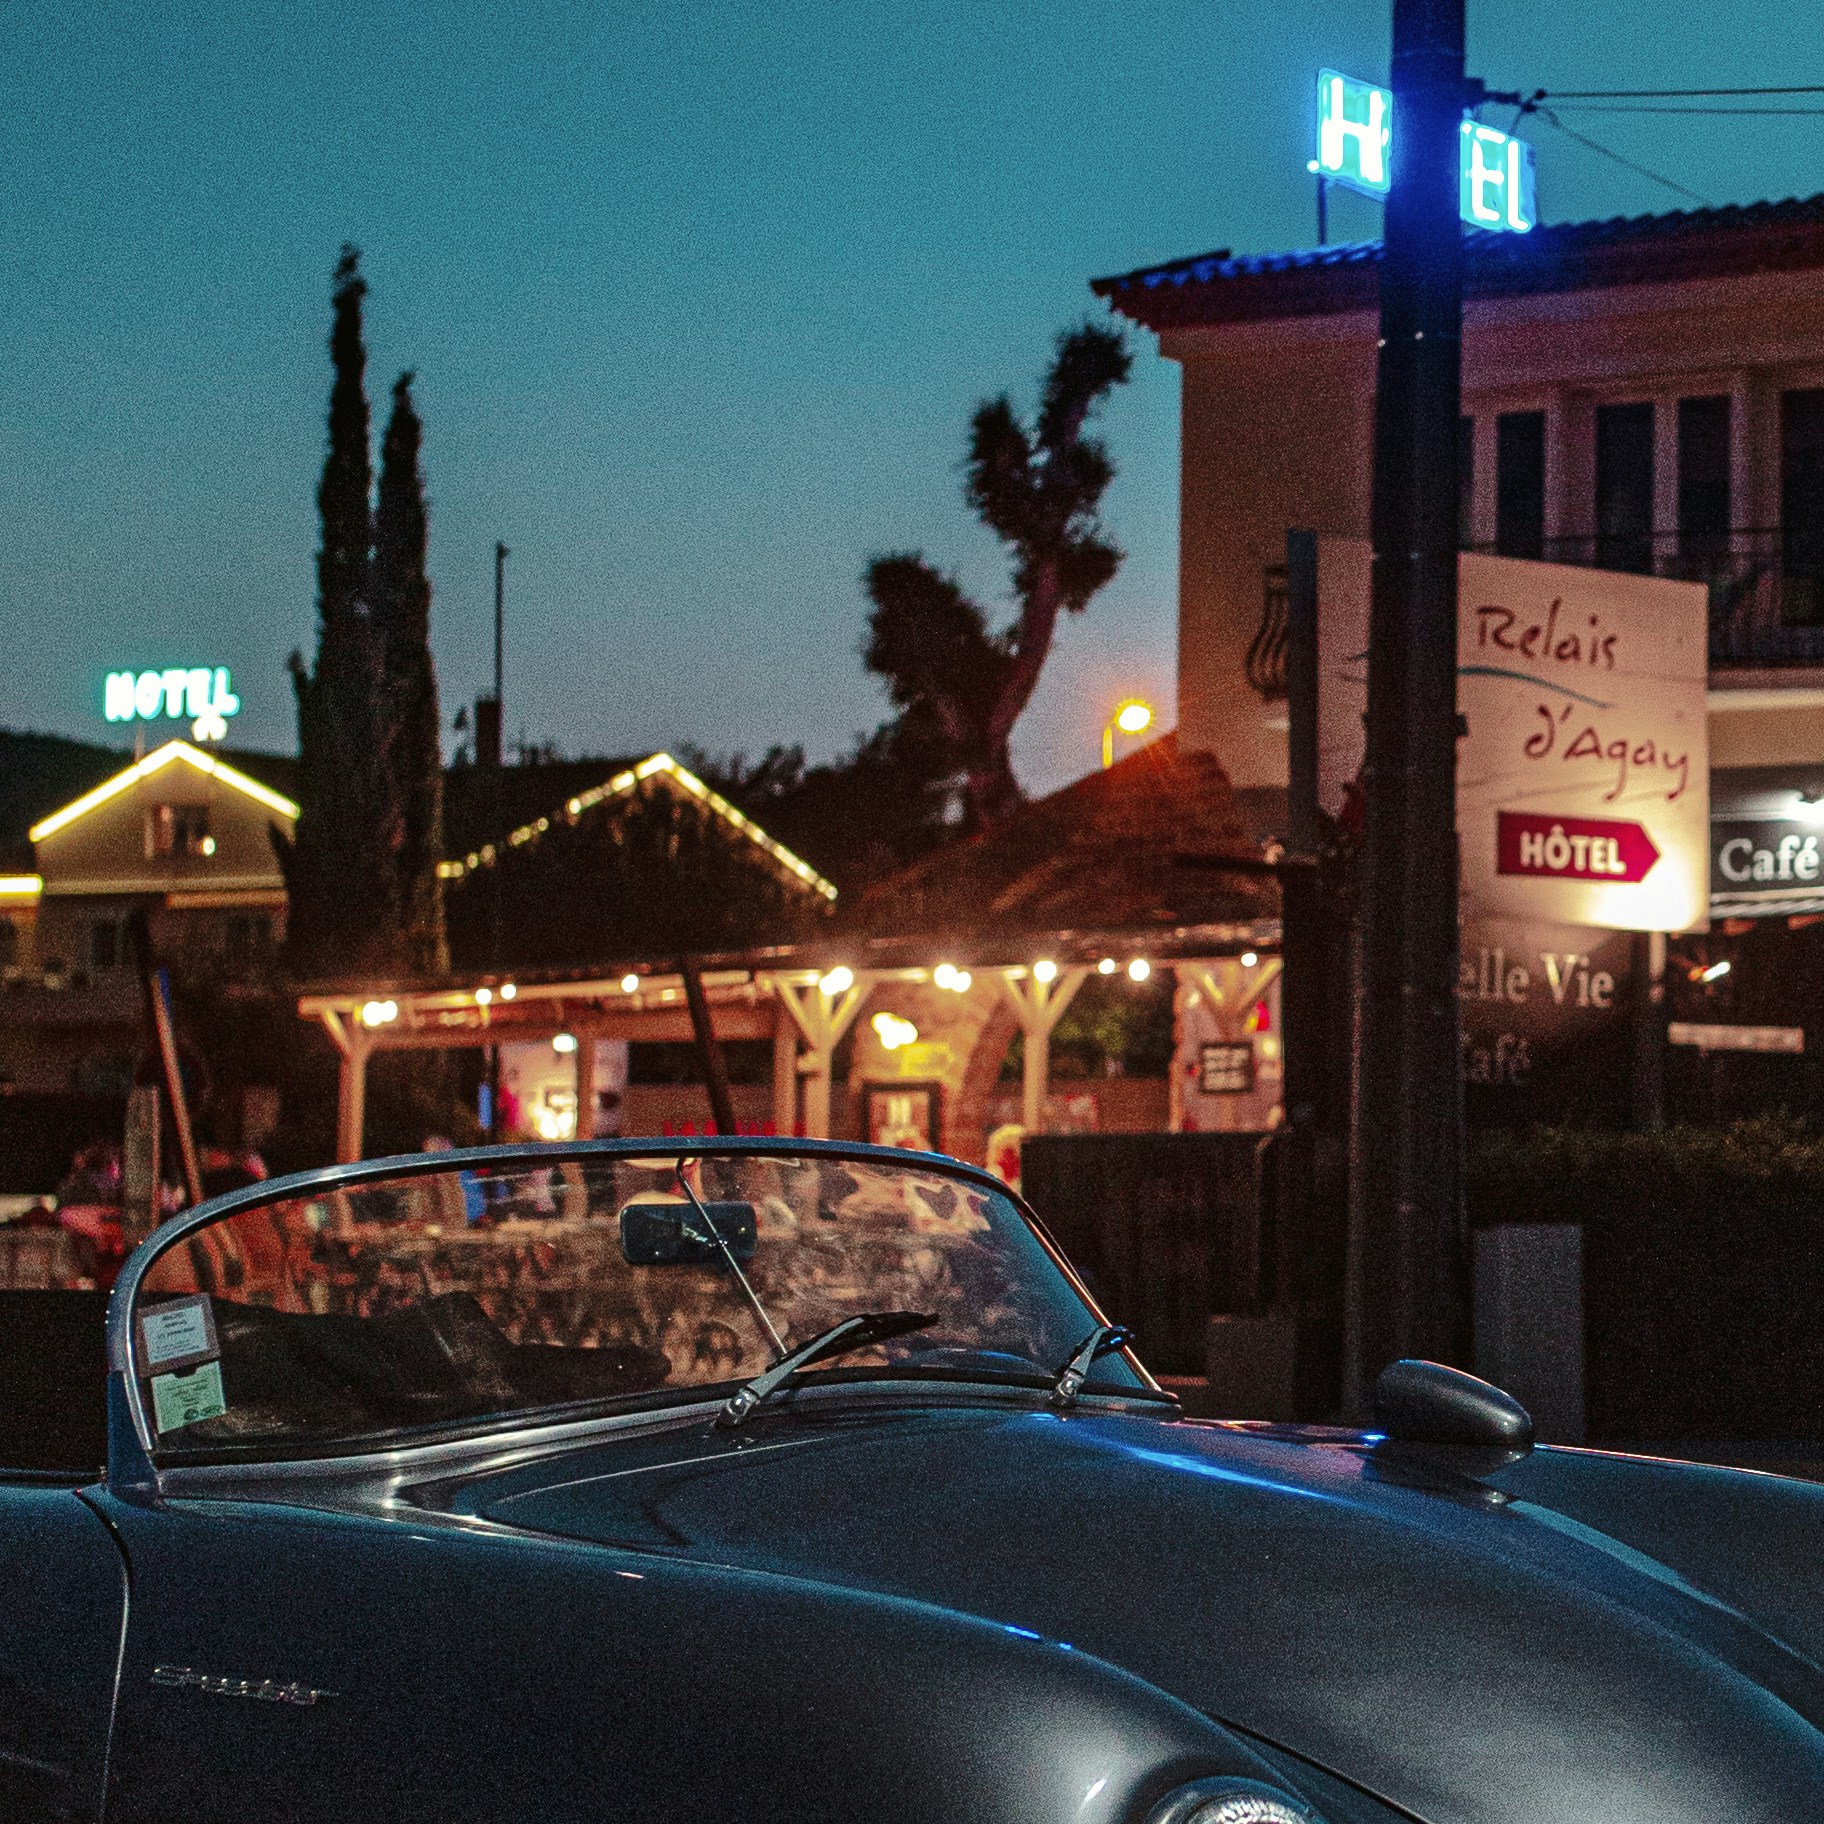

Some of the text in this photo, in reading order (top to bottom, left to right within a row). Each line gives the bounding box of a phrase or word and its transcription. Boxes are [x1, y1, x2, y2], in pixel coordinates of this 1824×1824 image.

[1316, 69, 1533, 234] HEL
[1476, 596, 1617, 671] Relais
[1523, 703, 1688, 803] d'Agay
[1518, 823, 1628, 875] HÔTEL
[1718, 834, 1820, 882] Café
[1541, 952, 1616, 1008] Vie
